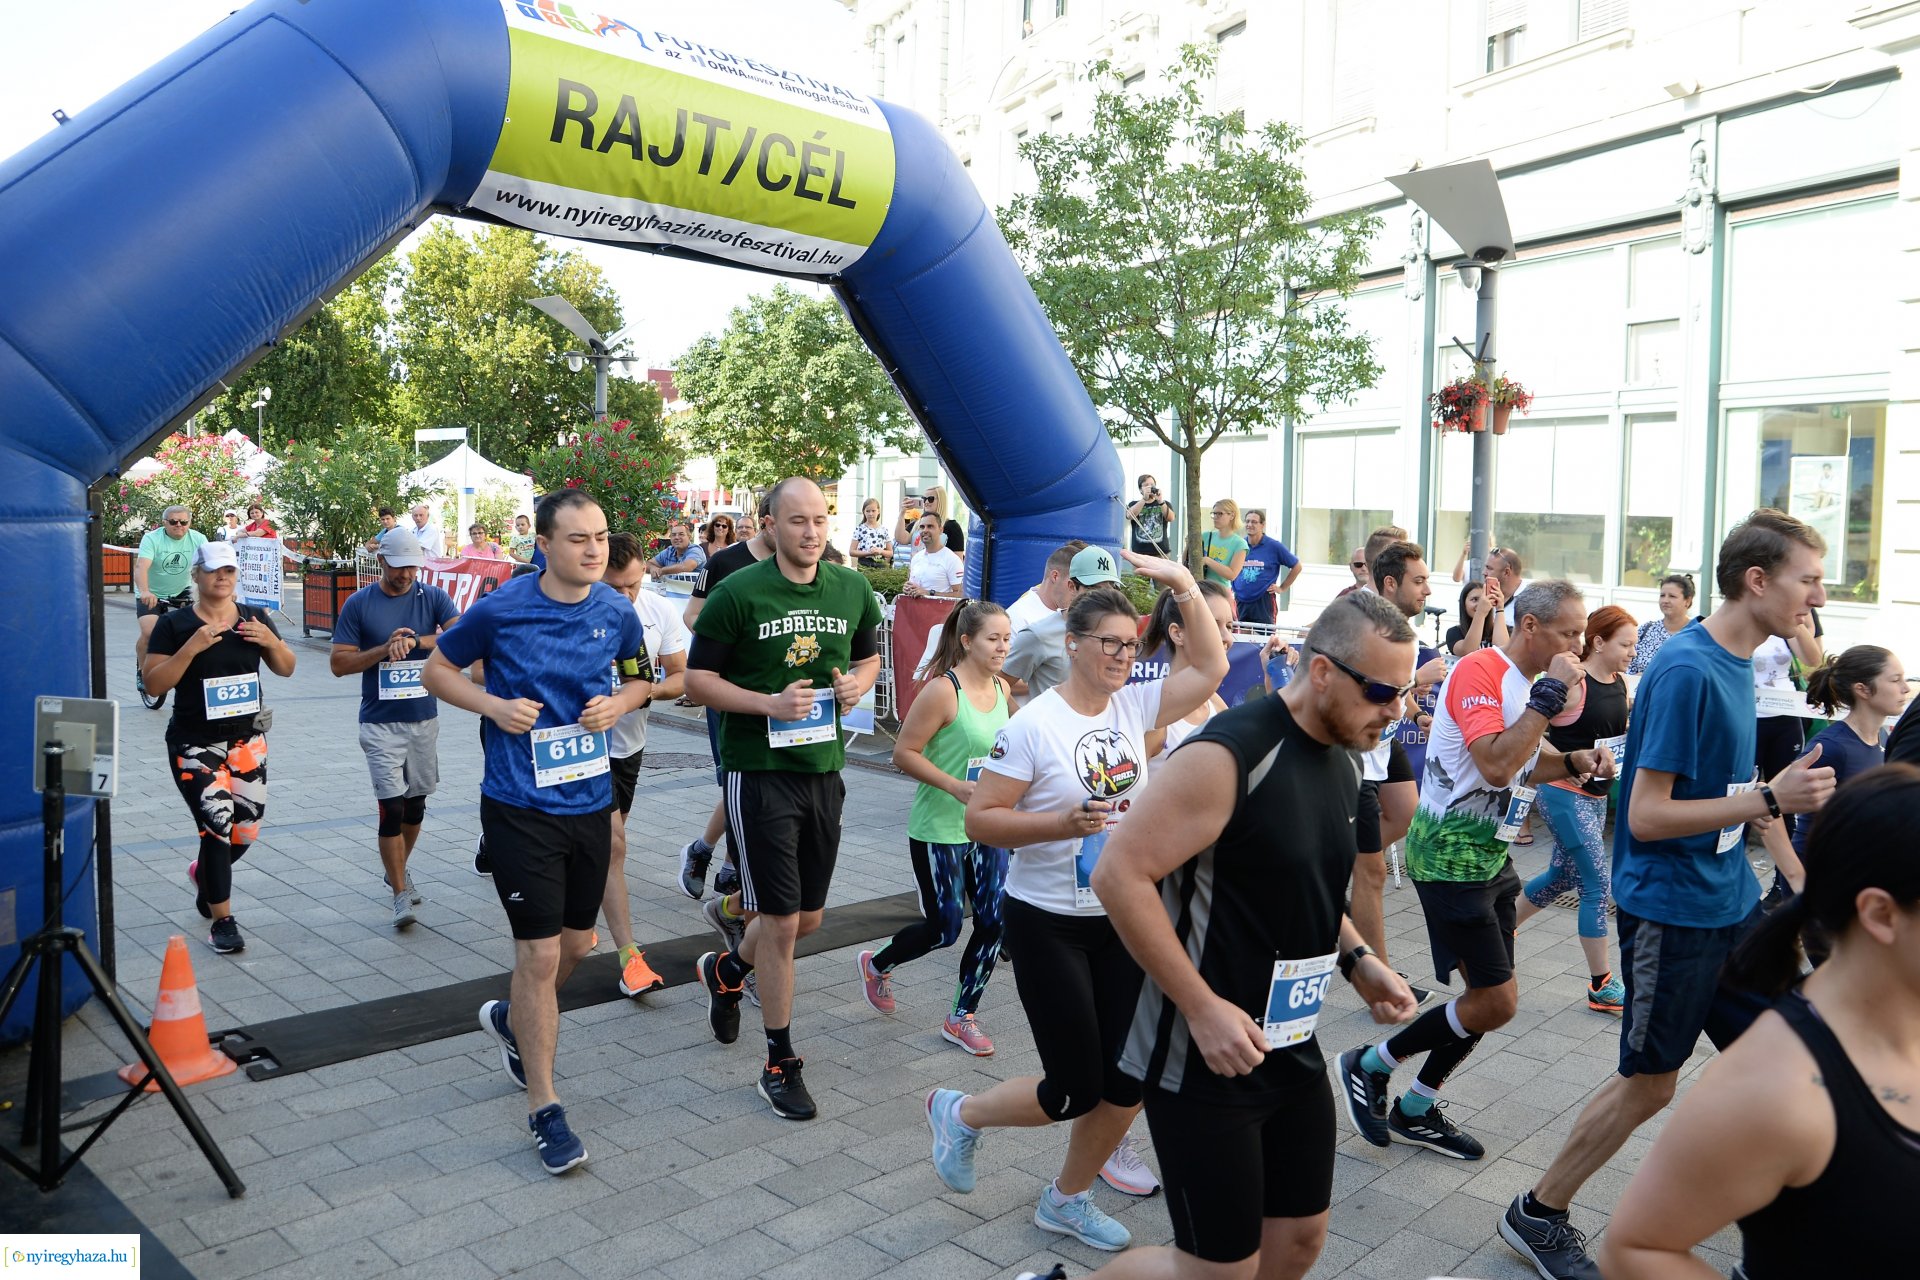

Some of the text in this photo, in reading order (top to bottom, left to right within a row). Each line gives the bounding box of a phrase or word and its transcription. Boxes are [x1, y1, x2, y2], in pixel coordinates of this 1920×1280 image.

[665, 48, 683, 60] az
[779, 80, 870, 115] támogatásával
[549, 77, 857, 210] RAJT/CÉL
[495, 188, 843, 267] www.nyiregyhazifutofesztival.hu
[1097, 556, 1109, 571] NY
[758, 615, 848, 640] DEBRECEN
[389, 669, 421, 684] 622
[217, 683, 250, 701] 623
[549, 734, 595, 761] 618
[98, 773, 108, 790] 7
[1111, 769, 1136, 784] TRAIL
[1288, 973, 1332, 1010] 650
